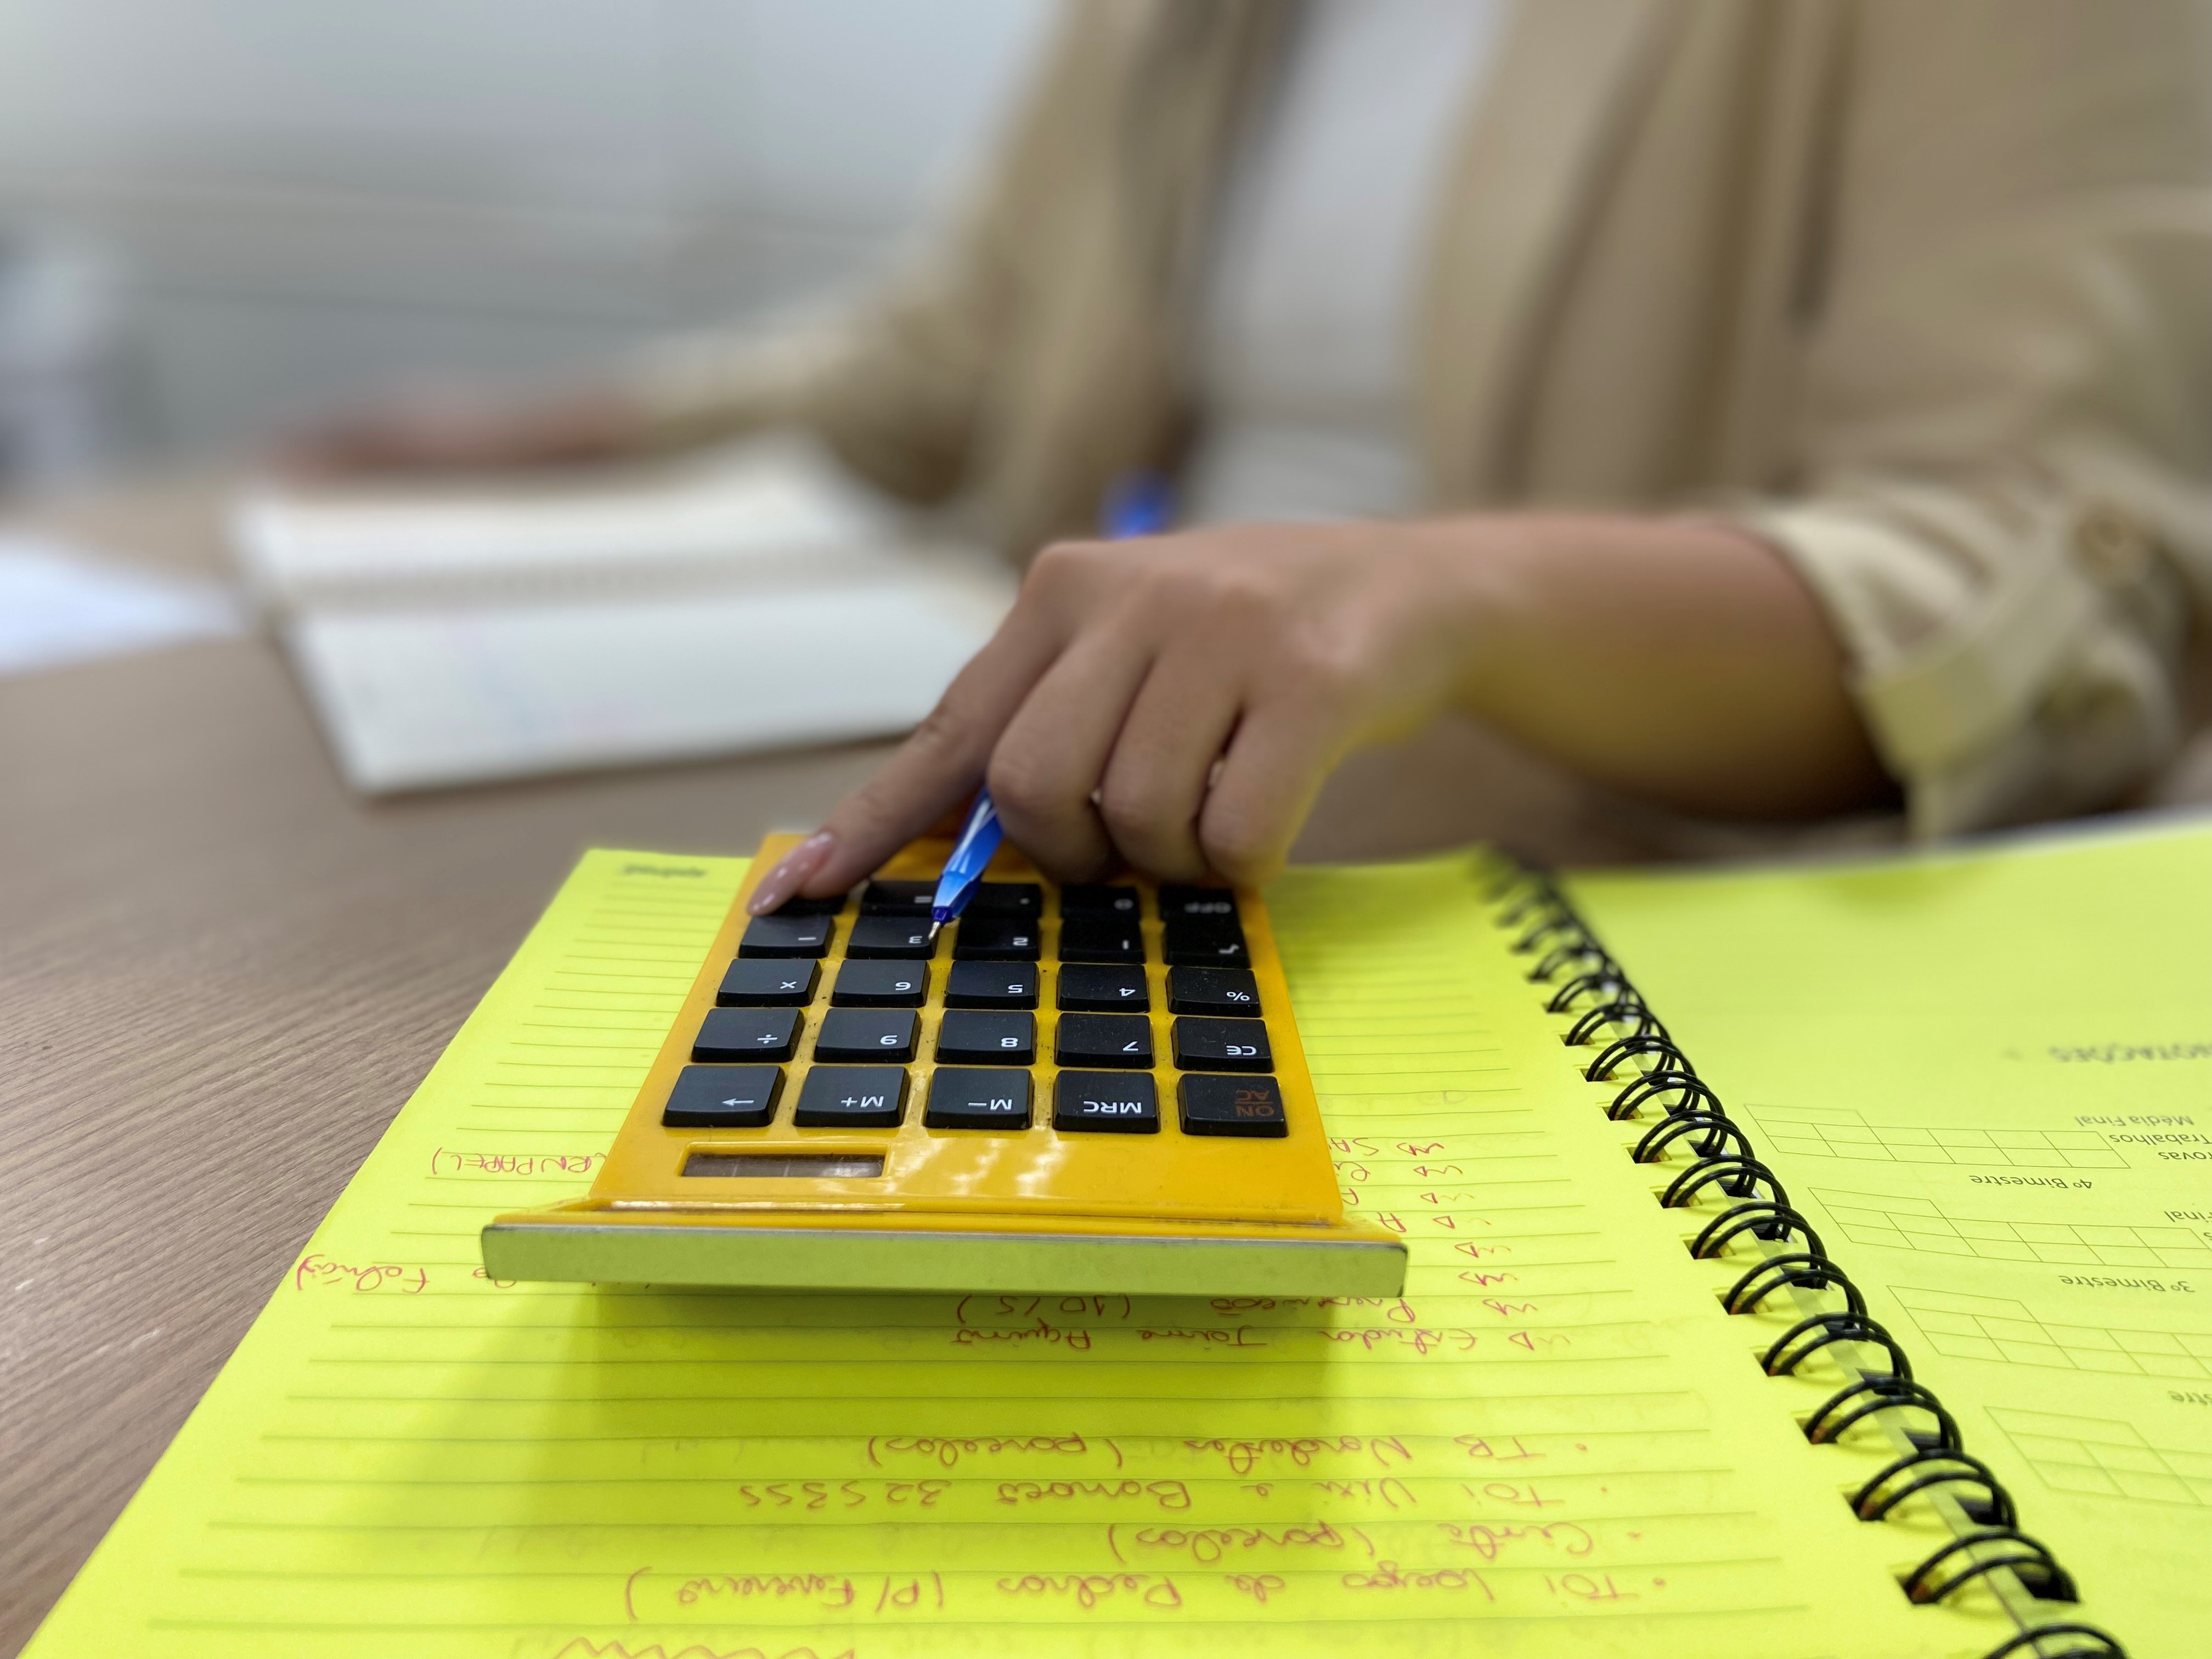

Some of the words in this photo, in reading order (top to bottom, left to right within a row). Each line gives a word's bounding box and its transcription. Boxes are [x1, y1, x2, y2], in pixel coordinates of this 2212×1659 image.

[909, 935, 923, 944] 3
[1012, 936, 1029, 946] 2
[895, 982, 911, 991] 6
[1007, 984, 1024, 994] 5
[1119, 988, 1136, 997] 4
[880, 1035, 898, 1045] 9
[1001, 1037, 1018, 1048] 8
[1122, 1041, 1139, 1052] 7
[1226, 1045, 1257, 1056] CE
[1235, 1090, 1271, 1101] AC
[1083, 1101, 1142, 1114] MRC
[1235, 1104, 1274, 1117] ON
[2073, 1115, 2126, 1127] Final
[2128, 1115, 2194, 1127] Média
[2108, 1134, 2212, 1146] Trabalhos
[1968, 1175, 2069, 1189] Bimestre
[2057, 1275, 2165, 1292] Bimestre
